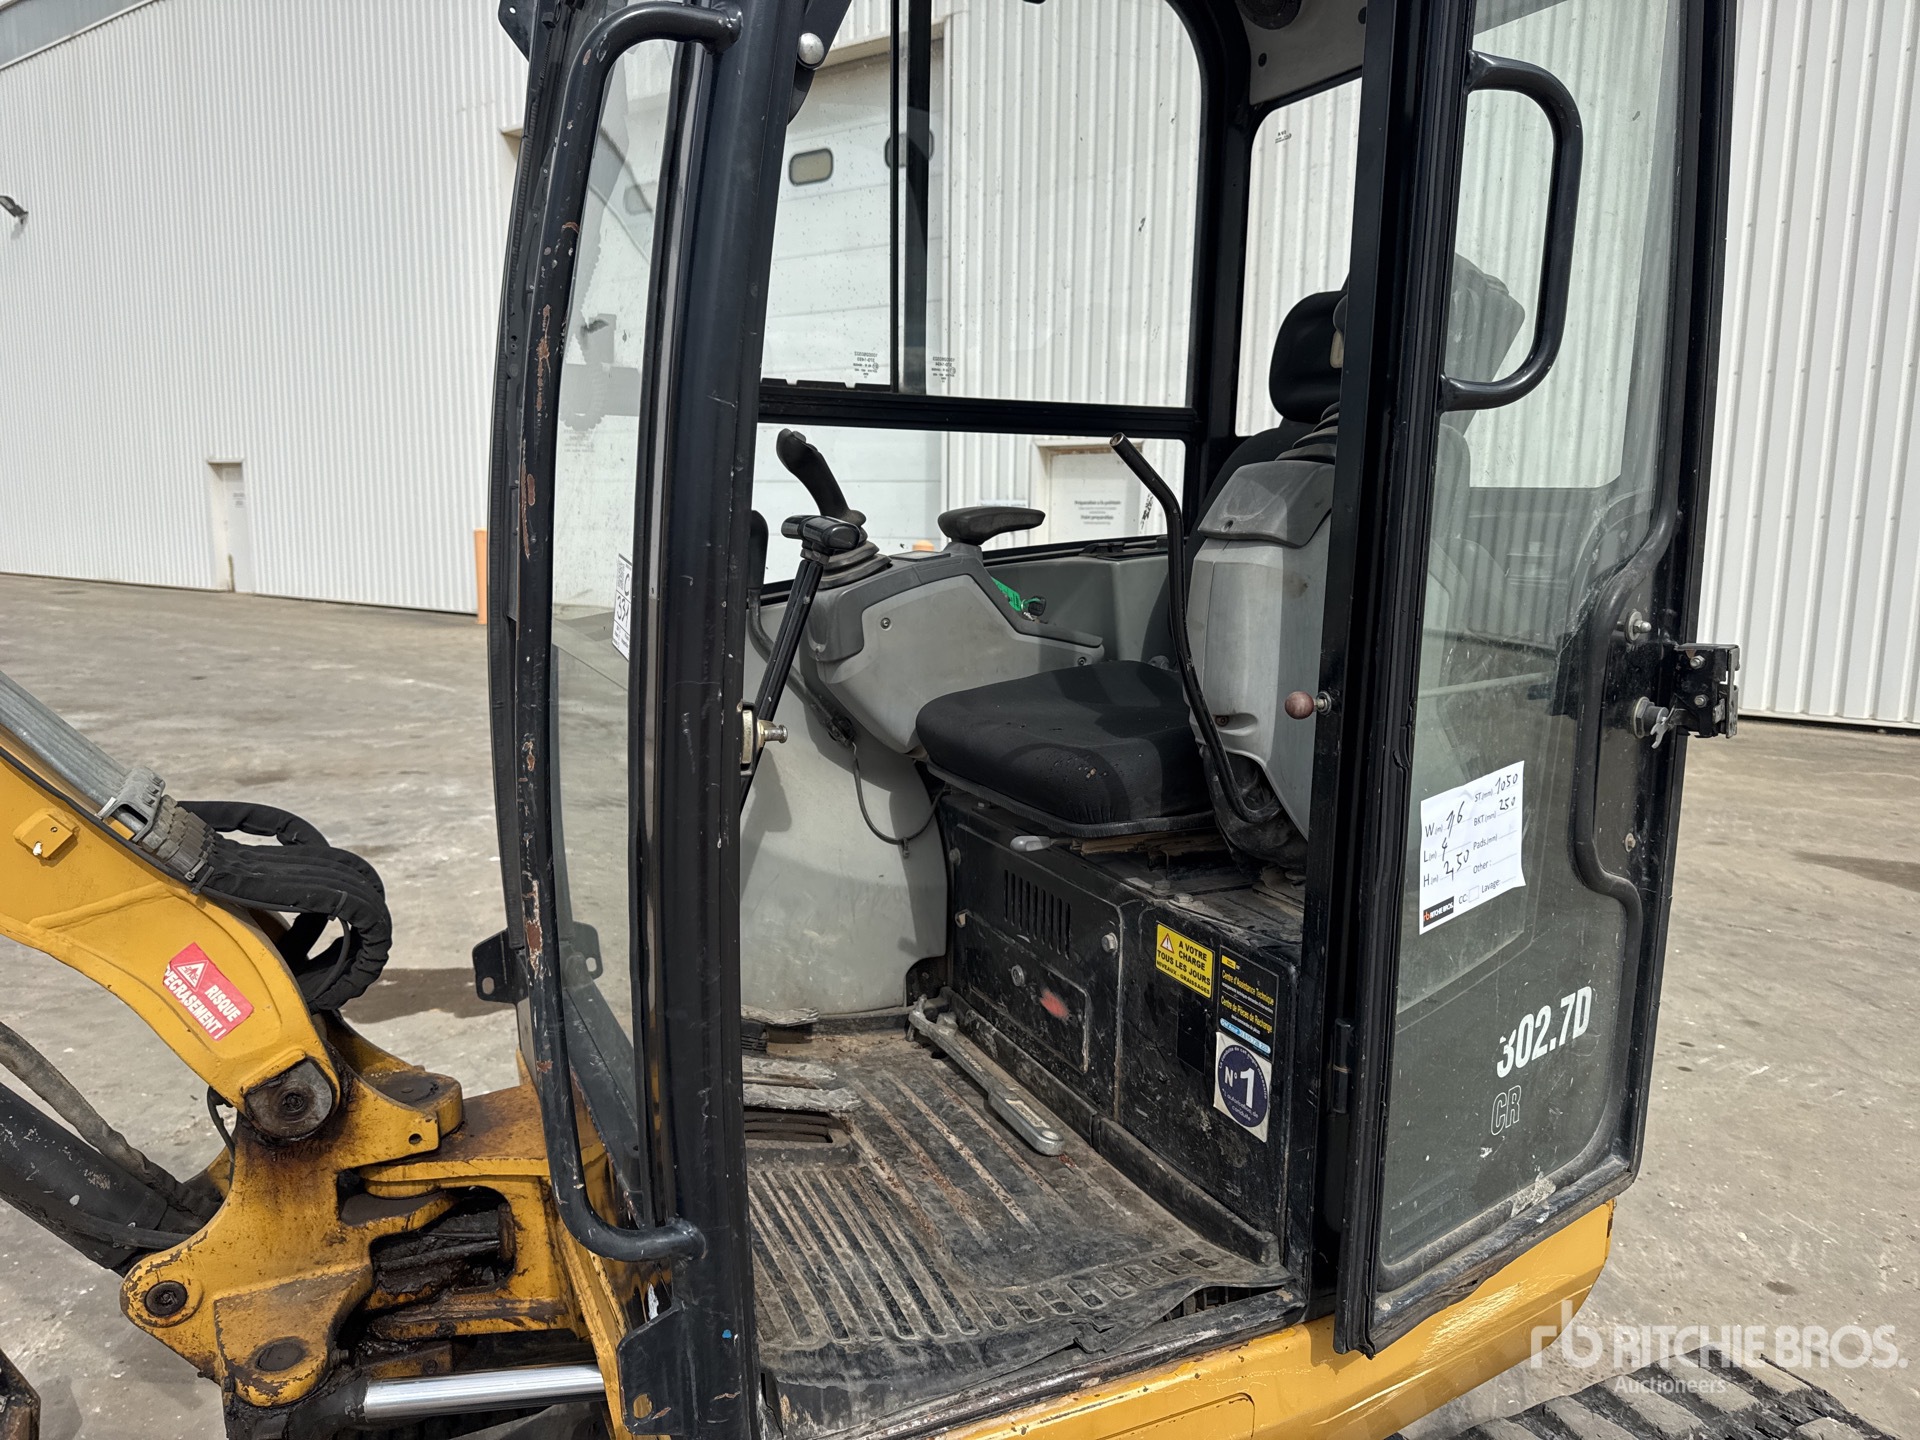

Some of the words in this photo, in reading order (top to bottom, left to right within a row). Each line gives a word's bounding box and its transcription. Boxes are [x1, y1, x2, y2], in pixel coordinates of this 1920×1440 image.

[1495, 773, 1518, 795] 1050
[1498, 796, 1516, 811] 250
[1178, 940, 1184, 949] A
[1184, 943, 1208, 962] VOTRE
[1178, 950, 1206, 971] CHARGE
[1157, 950, 1174, 967] TOUS
[1175, 959, 1188, 973] LES
[1188, 967, 1211, 986] JOURS
[204, 984, 242, 1023] RISQUE
[1496, 986, 1592, 1078] 302.7D
[1490, 1084, 1522, 1136] CR
